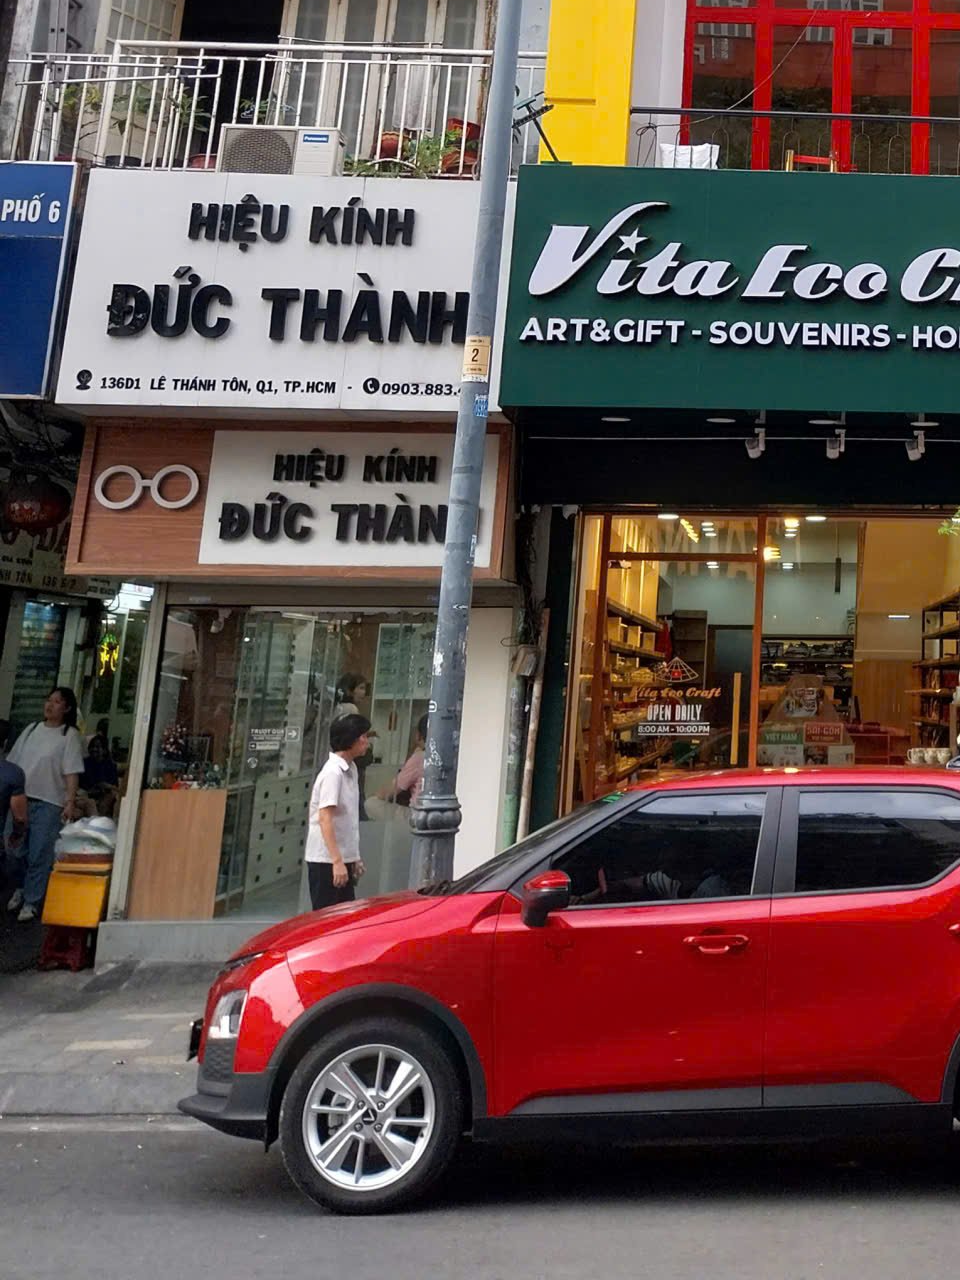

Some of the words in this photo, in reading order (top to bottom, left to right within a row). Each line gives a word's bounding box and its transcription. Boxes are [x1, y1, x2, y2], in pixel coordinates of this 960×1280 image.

[1, 193, 46, 222] PHỐ
[48, 200, 61, 223] 6
[188, 193, 290, 252] HIỆU
[308, 196, 416, 247] KÍNH
[528, 201, 739, 296] Vita
[741, 244, 888, 300] Eco
[106, 265, 234, 339] ĐỨC
[261, 272, 471, 344] THÀNH
[519, 317, 685, 344] ART&GIFT
[709, 320, 891, 348] SOUVENIRS
[471, 348, 479, 362] 2
[100, 377, 141, 391] 136D1
[150, 376, 167, 391] LÊ
[172, 376, 217, 392] THÁNH
[222, 376, 251, 394] TÔN,
[256, 380, 278, 395] Q1,
[284, 380, 336, 394] TP.HCM
[273, 448, 346, 488] HIỆU
[363, 448, 438, 483] KÍNH
[219, 492, 314, 541] ĐỨC
[331, 493, 454, 543] THÀN
[684, 687, 721, 699] Craft
[647, 704, 671, 721] OPEN
[675, 704, 702, 721] DAILY
[637, 725, 656, 734] 8:00
[657, 725, 670, 733] AM
[677, 725, 697, 734] 10:00
[699, 726, 710, 734] PM
